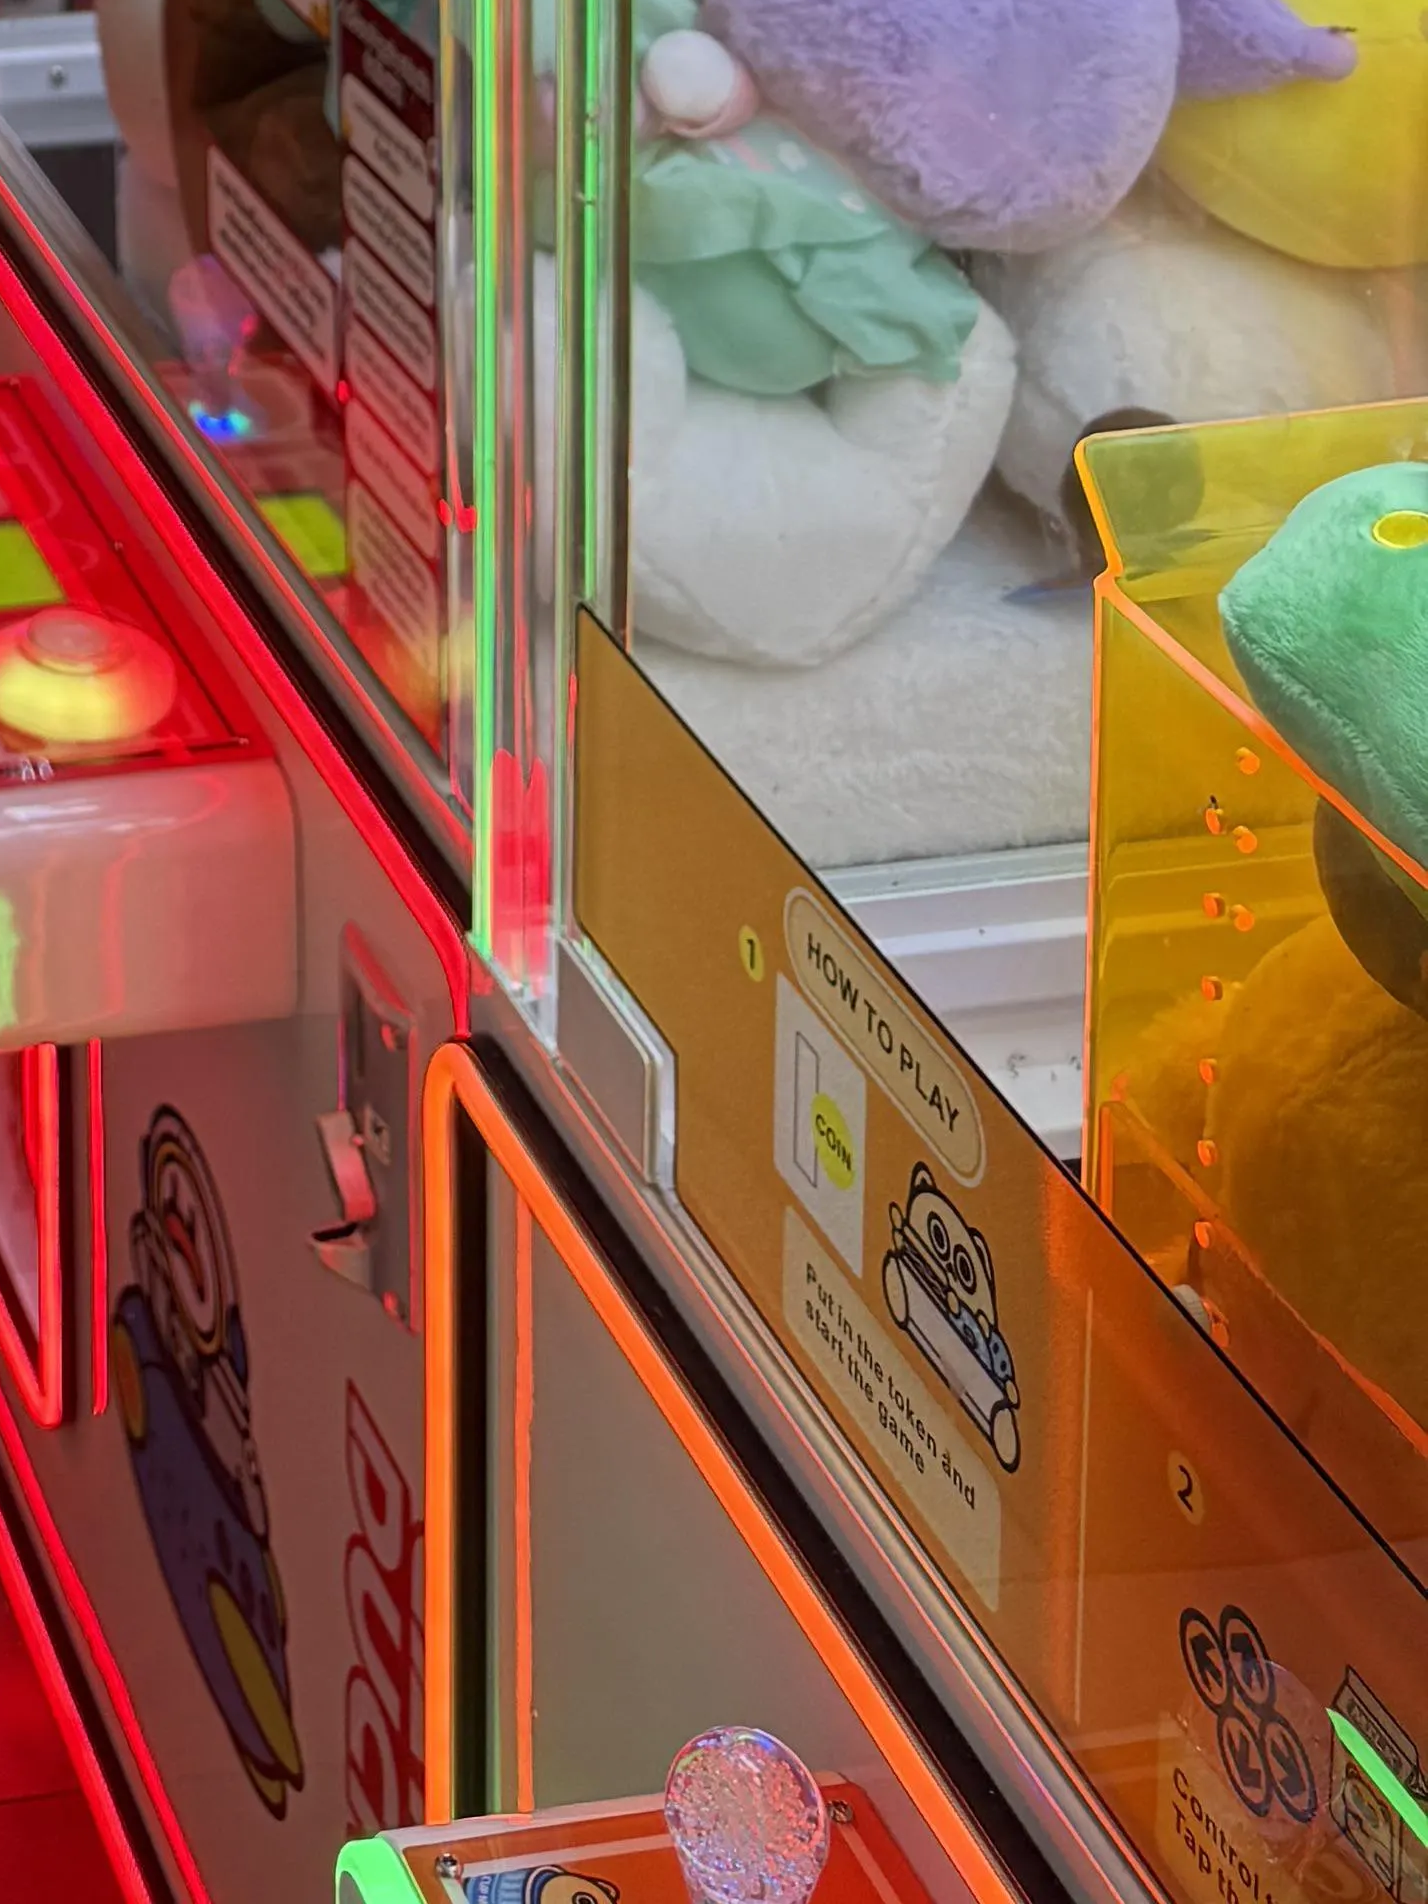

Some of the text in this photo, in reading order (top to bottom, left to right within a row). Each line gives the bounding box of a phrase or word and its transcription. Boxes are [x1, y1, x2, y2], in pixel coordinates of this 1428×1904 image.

[745, 938, 756, 971] 1
[807, 932, 960, 1132] HOW TO PLAY
[815, 1113, 852, 1172] COIN
[804, 1298, 925, 1475] start the game
[805, 1261, 977, 1511] Put in the token and
[1176, 1464, 1194, 1514] 2
[1171, 1800, 1212, 1875] Tap
[1172, 1767, 1260, 1902] Control
